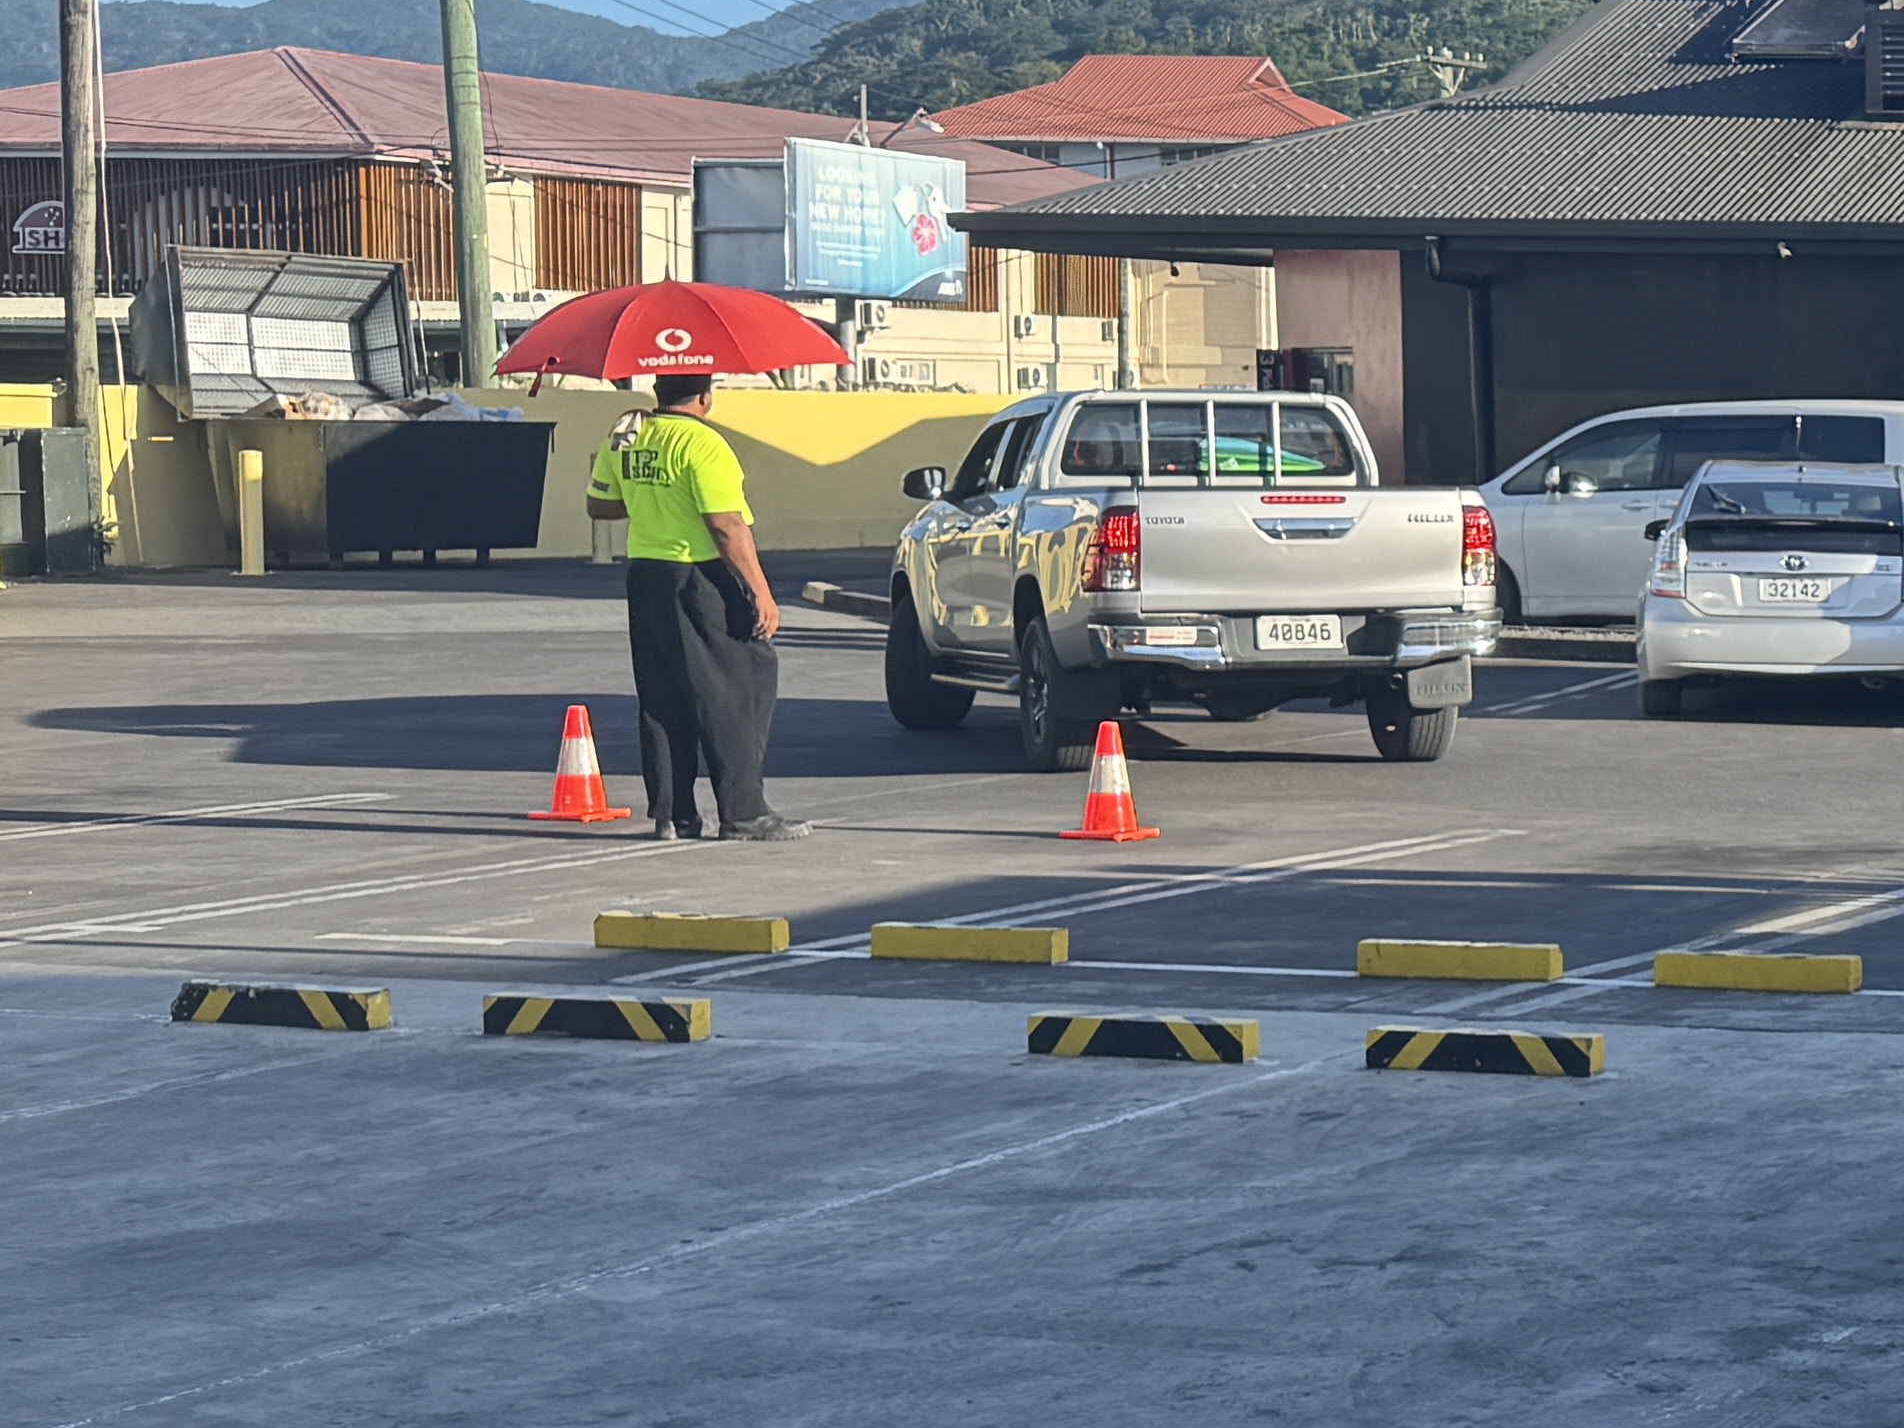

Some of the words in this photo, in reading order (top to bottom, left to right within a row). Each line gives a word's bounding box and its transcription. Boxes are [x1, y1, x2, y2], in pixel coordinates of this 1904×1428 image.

[638, 354, 714, 367] vodafone
[1767, 582, 1821, 598] 32142
[1268, 622, 1332, 642] 40846
